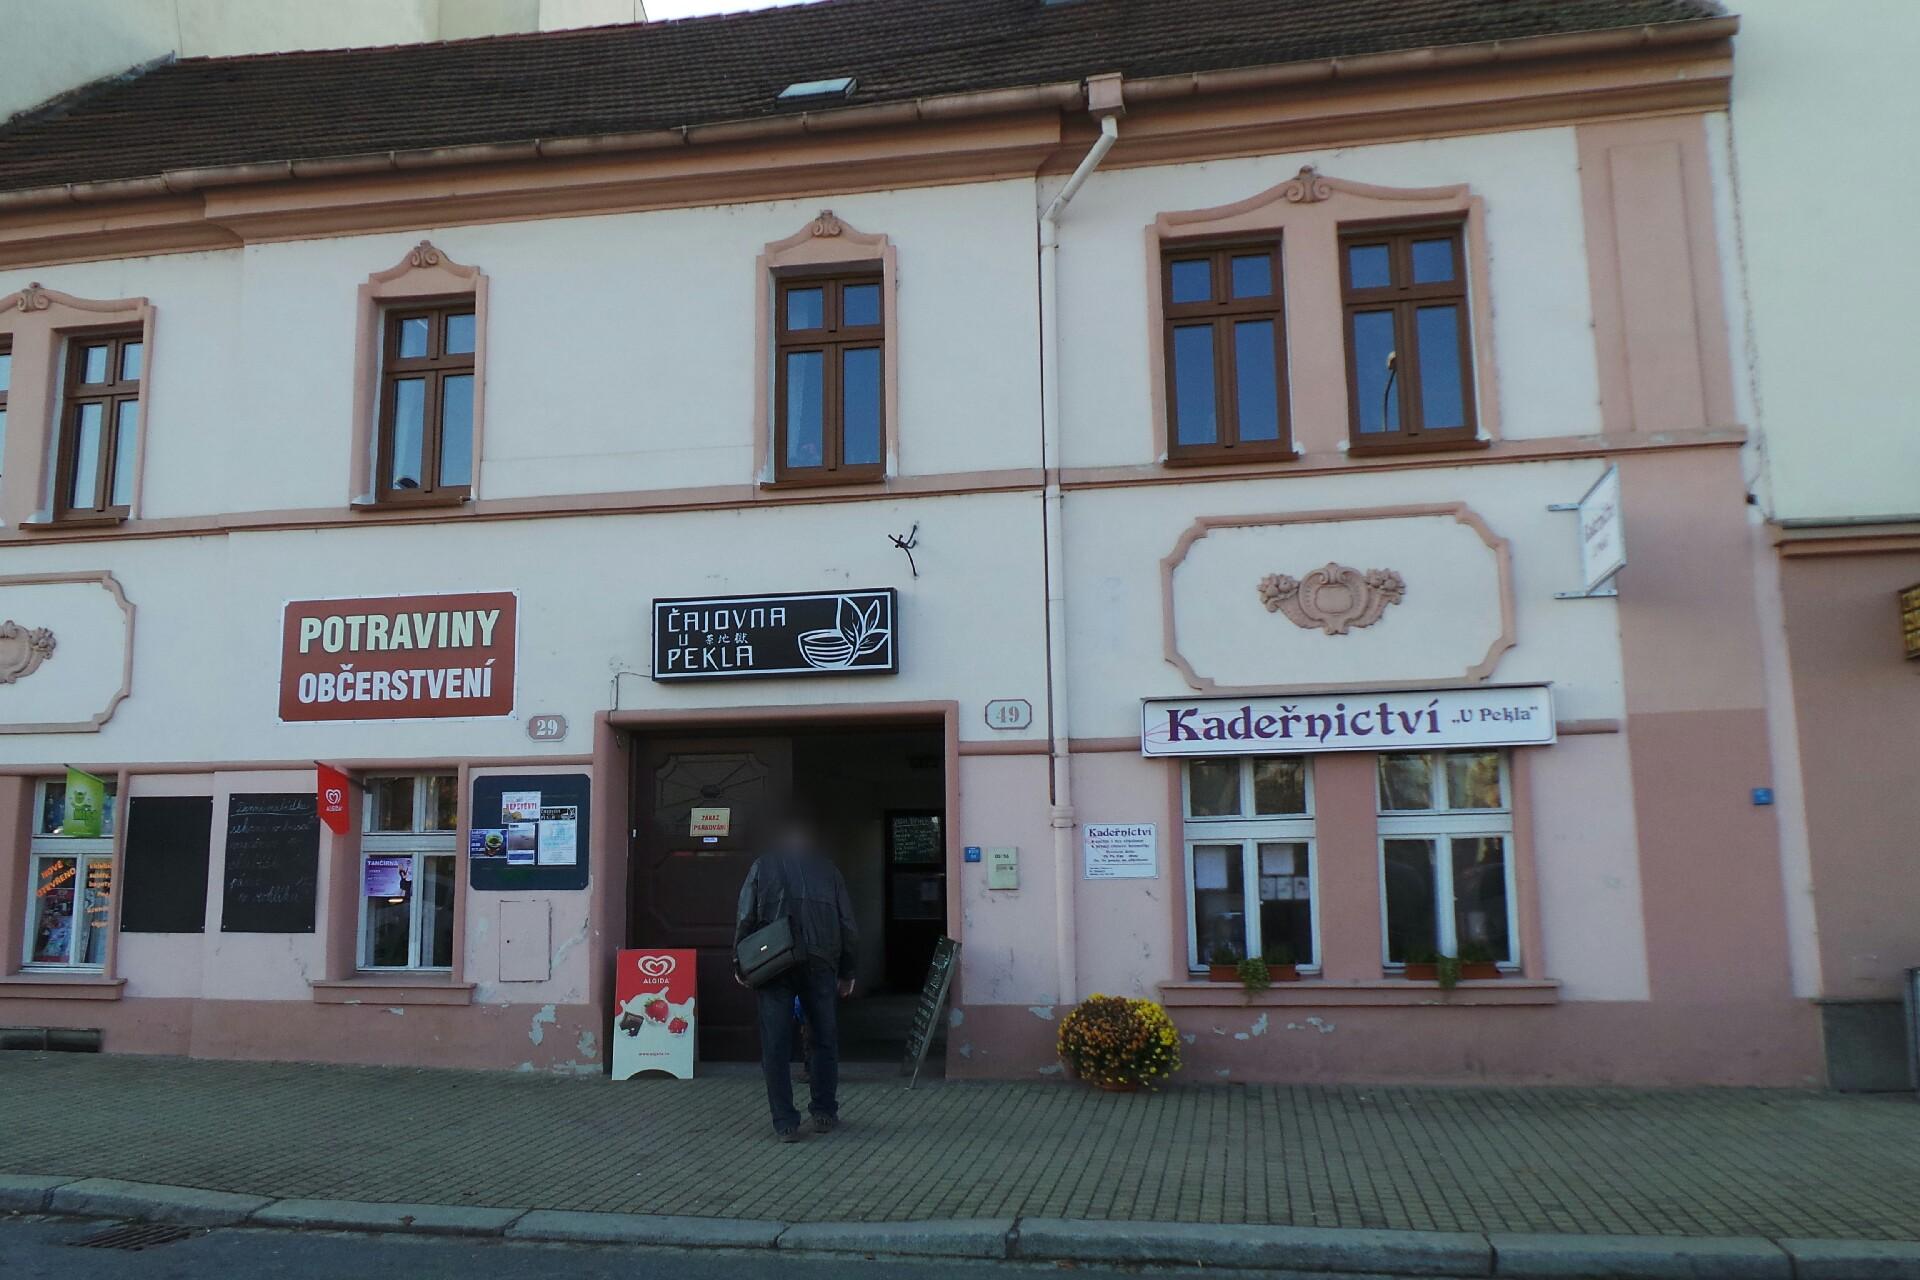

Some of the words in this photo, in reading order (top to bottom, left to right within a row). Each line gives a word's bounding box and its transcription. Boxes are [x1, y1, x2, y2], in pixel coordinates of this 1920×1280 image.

[299, 609, 500, 653] POTRAVINY
[668, 607, 786, 633] ČAJOVNA
[678, 635, 689, 647] U
[667, 645, 753, 670] PEKLA
[298, 658, 496, 703] OBČERSTVENÍ
[996, 705, 1019, 723] 49
[1166, 699, 1441, 743] Kadeřnictví
[536, 719, 558, 736] 29
